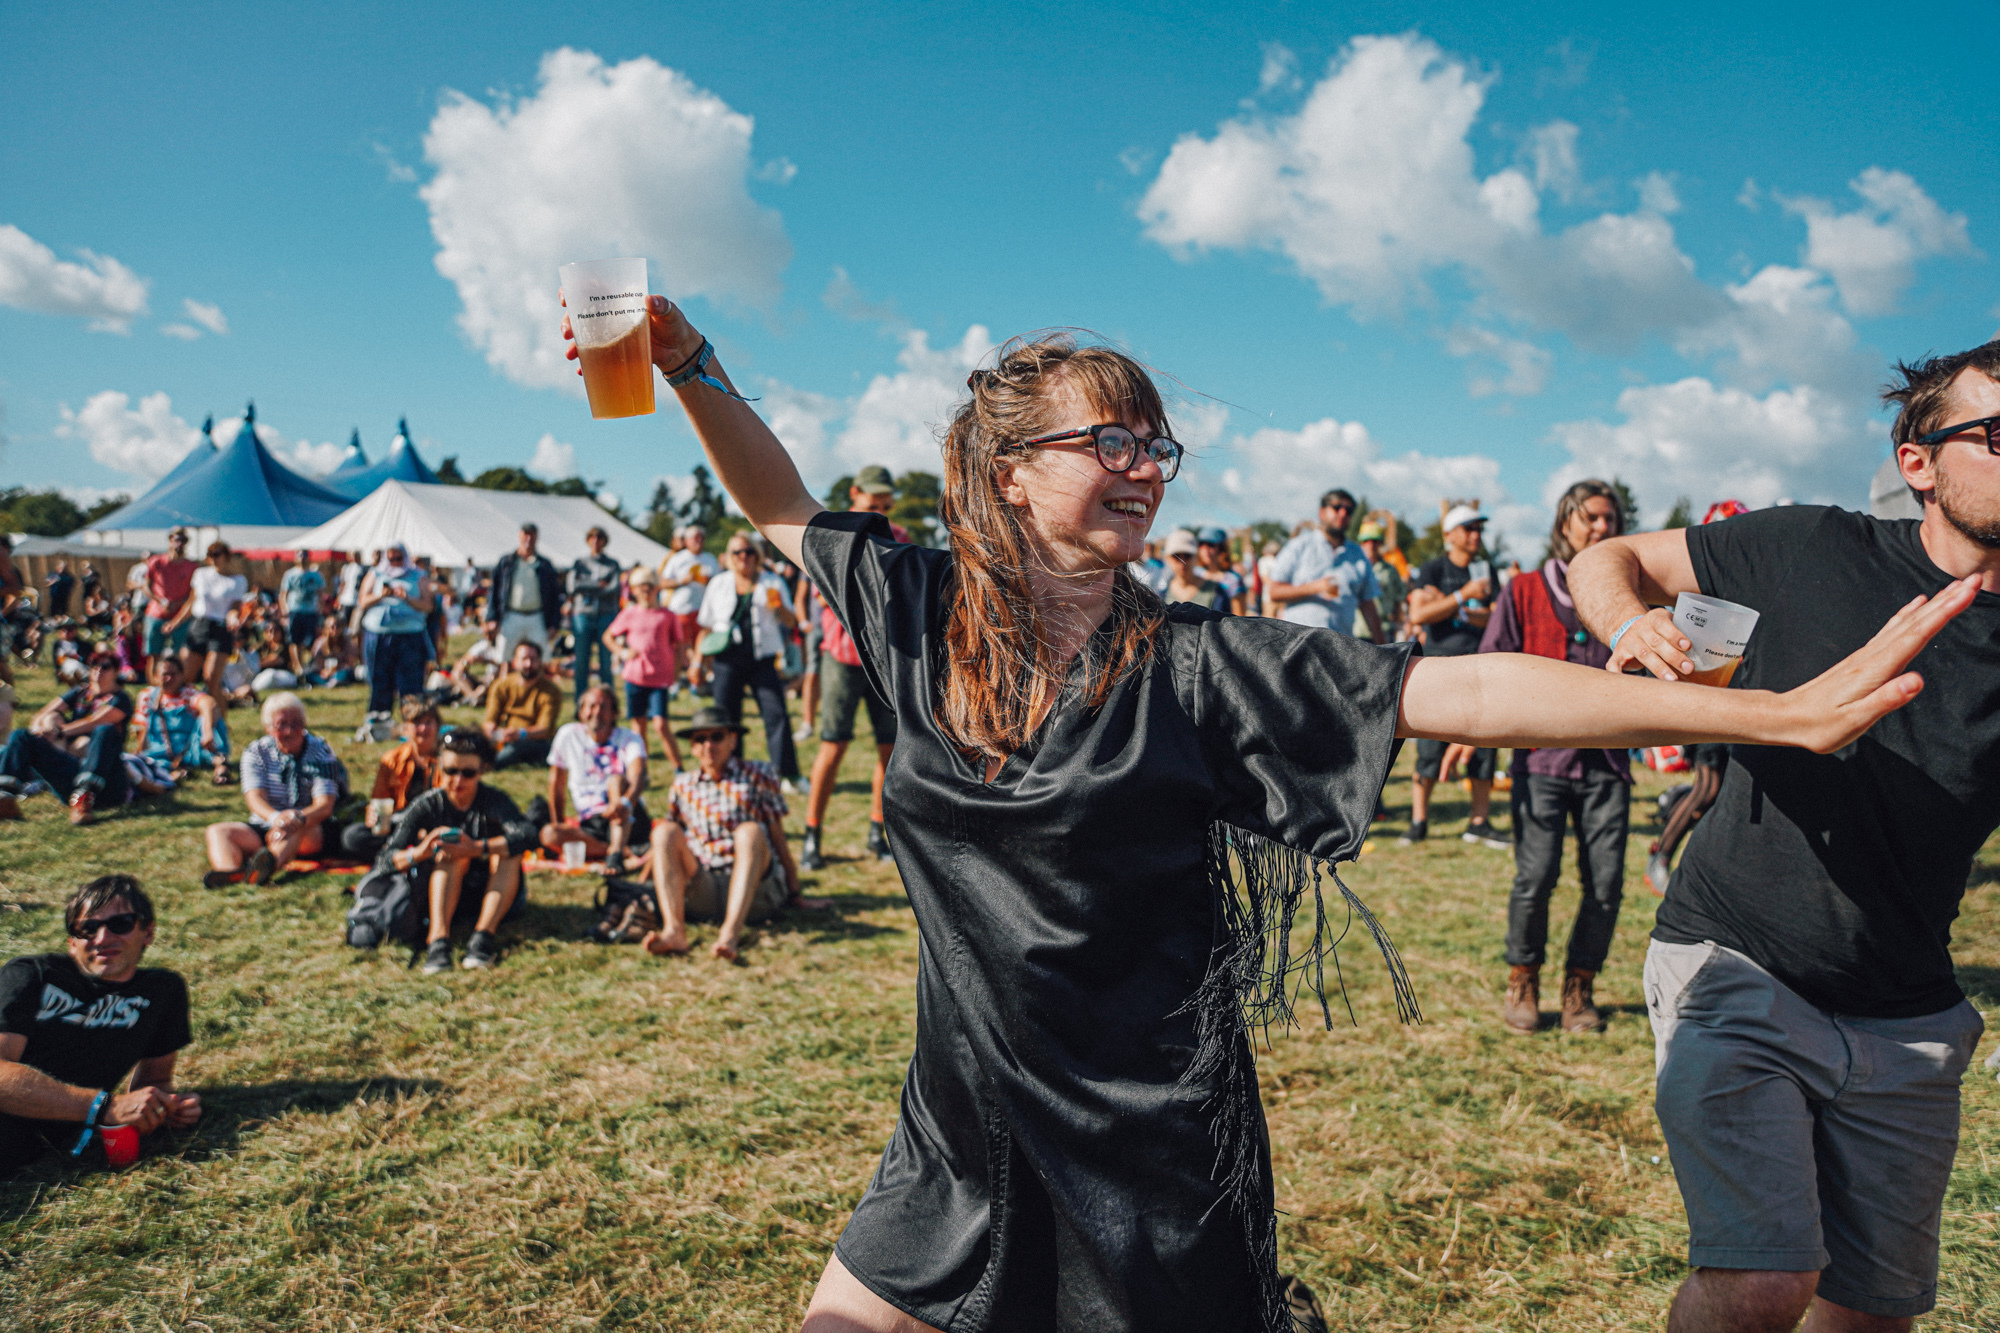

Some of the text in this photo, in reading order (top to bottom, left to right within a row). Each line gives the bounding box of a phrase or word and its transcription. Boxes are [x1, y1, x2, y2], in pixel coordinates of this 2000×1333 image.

[606, 292, 634, 300] reusable
[595, 309, 614, 318] don't
[1705, 649, 1724, 657] Please
